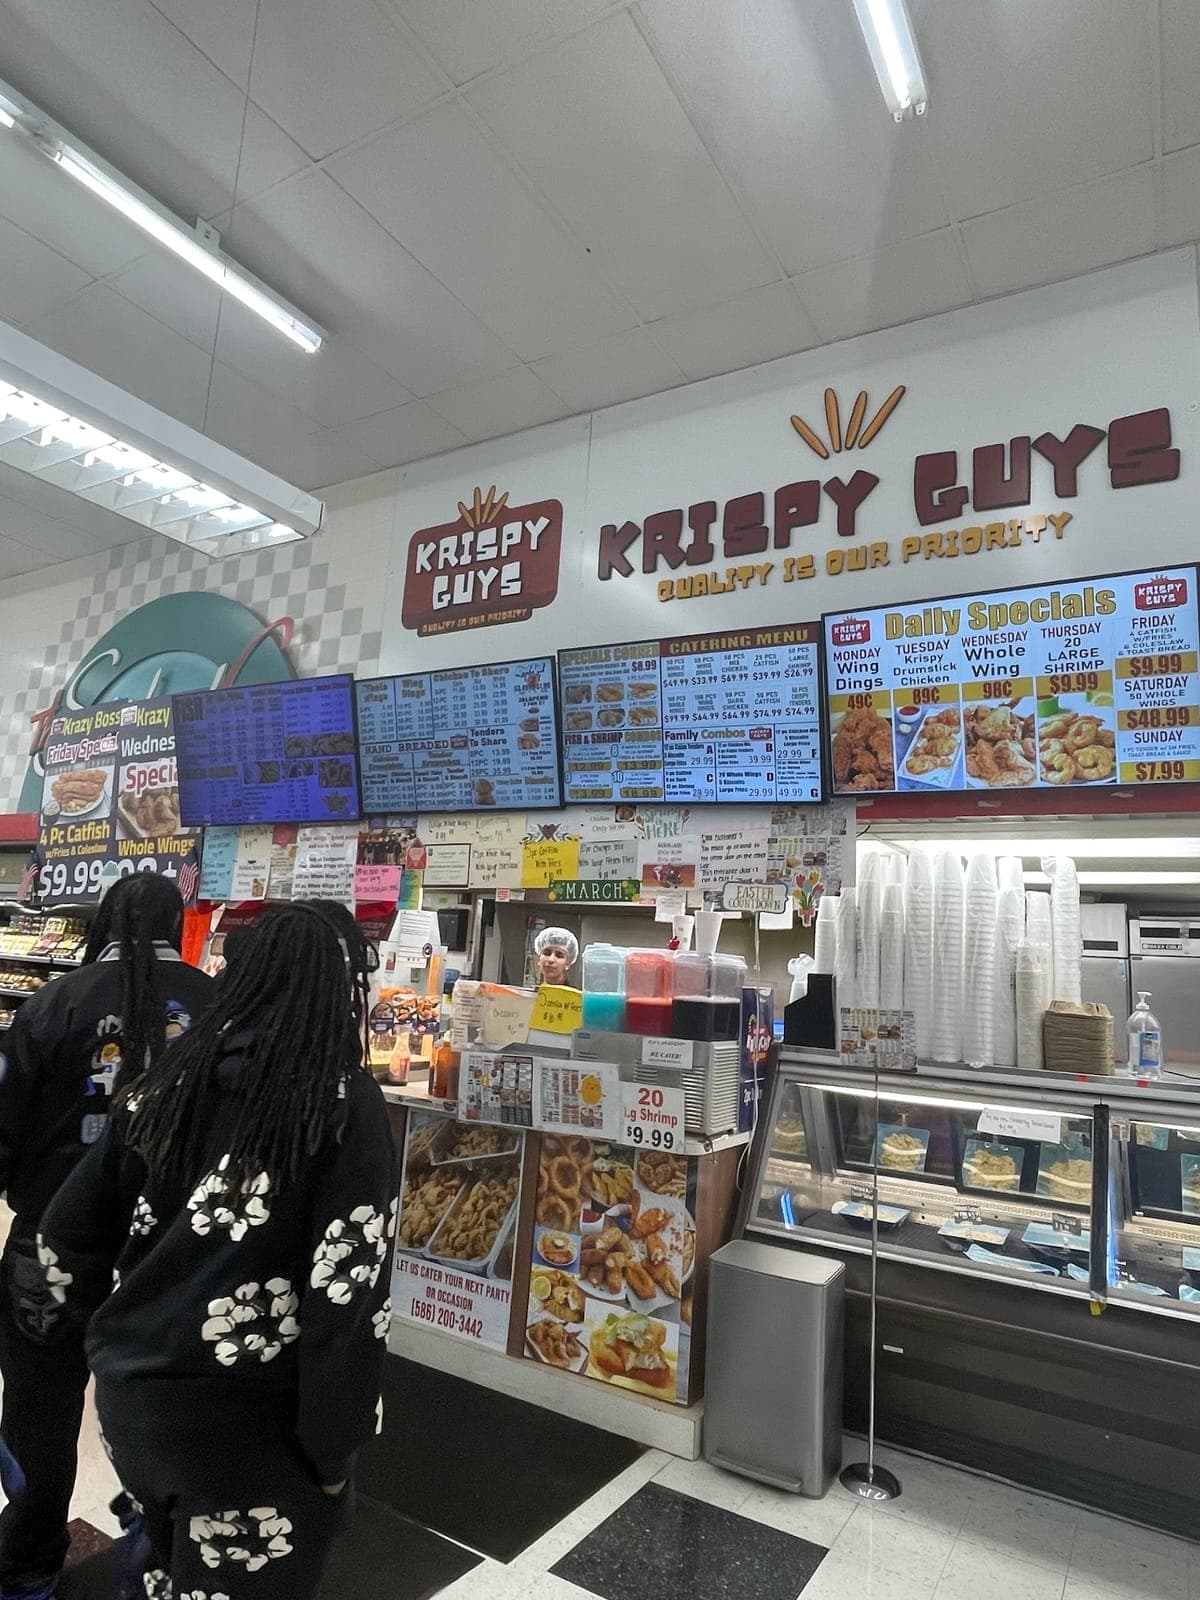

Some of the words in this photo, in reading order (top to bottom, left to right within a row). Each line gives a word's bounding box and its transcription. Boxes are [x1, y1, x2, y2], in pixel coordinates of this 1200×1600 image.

[597, 468, 880, 581] KRISPY
[912, 406, 1182, 527] GUYS
[415, 515, 551, 574] KRISPY
[657, 561, 774, 602] QUALITY
[783, 552, 816, 582] IS
[825, 541, 889, 575] OUR
[902, 511, 1073, 563] PRIORITY
[432, 561, 522, 611] GUYS
[422, 619, 456, 633] QUALITY
[457, 617, 467, 628] IS
[468, 614, 485, 626] OUR
[488, 607, 528, 623] PRIORITY
[884, 607, 962, 641] Daily
[967, 587, 1117, 632] Specials
[1131, 614, 1175, 629] FRIDAY
[1041, 622, 1102, 639] THURSDAY
[1137, 627, 1177, 636] CATFISH
[669, 635, 751, 654] CATERING
[756, 629, 808, 645] MENU
[961, 630, 1028, 648] WEDNESDAY
[1064, 637, 1081, 648] 20
[895, 639, 950, 655] TUESDAY
[965, 645, 1026, 661] Whole
[833, 647, 881, 662] MONDAY
[904, 653, 944, 664] Krispy
[1048, 647, 1099, 662] LARGE
[838, 661, 879, 675] Wing
[893, 662, 957, 676] Drumstick
[971, 663, 1020, 677] Wing
[1044, 660, 1104, 674] SHRIMP
[1130, 653, 1182, 678] $9.99
[721, 673, 749, 683] $69.99
[752, 671, 781, 681] $39.99
[784, 668, 813, 679] $26.99
[900, 675, 950, 686] Chicken
[663, 679, 688, 688] $49.99
[691, 676, 718, 686] $33.99
[836, 677, 883, 691] Dings
[1050, 672, 1098, 695] $9.99
[1124, 675, 1189, 692] SATURDAY
[912, 688, 940, 704] 89¢
[982, 680, 1012, 699] 98¢
[1129, 692, 1142, 700] 50
[1145, 689, 1186, 698] WHOLE
[848, 694, 873, 710] 49¢
[1139, 699, 1176, 708] WINGS
[137, 706, 170, 727] Krazy
[664, 714, 689, 724] $99.99
[692, 712, 719, 722] $64.99
[722, 711, 750, 721] $64.99
[753, 709, 782, 719] $74.99
[785, 707, 815, 717] $74.99
[1126, 707, 1190, 730] $48.99
[63, 713, 94, 736] Krazy
[95, 709, 121, 729] Boss
[470, 728, 505, 737] Tenders
[591, 732, 623, 744] SHRIMP
[665, 730, 698, 741] Family
[701, 728, 746, 740] Combos
[1134, 730, 1183, 744] SUNDAY
[47, 741, 80, 764] Friday
[79, 731, 119, 761] Special
[121, 735, 176, 757] Wednes
[365, 744, 392, 754] HAND
[398, 740, 449, 752] BREADED
[470, 738, 479, 747] To
[481, 737, 508, 746] Share
[766, 743, 773, 752] B
[706, 745, 713, 754] A
[811, 749, 817, 758] F
[706, 773, 713, 783] C
[767, 772, 774, 782] D
[1136, 761, 1184, 781] $7.99
[749, 788, 773, 797] 29.99
[810, 788, 818, 797] G
[40, 830, 48, 846] 4
[50, 829, 64, 845] Pc
[67, 821, 110, 843] Catfish
[592, 825, 606, 833] Only
[647, 822, 680, 840] HERE
[71, 846, 76, 855] &
[118, 839, 155, 857] Whole
[157, 838, 195, 856] Wings
[38, 860, 104, 900] $9.99
[566, 883, 622, 899] MARCH
[737, 885, 774, 899] EASTER
[728, 897, 780, 910] COUNTDOWN
[638, 1087, 664, 1108] 20
[640, 1108, 678, 1128] Shrimp
[627, 1126, 674, 1150] $9.99
[396, 1259, 409, 1272] LET
[410, 1262, 419, 1275] US
[421, 1265, 443, 1281] CATER
[445, 1272, 463, 1289] YOUR
[464, 1278, 484, 1296] NEXT
[485, 1285, 510, 1304] PARTY
[426, 1286, 436, 1299] OR
[437, 1290, 473, 1311] OCCASION
[411, 1298, 435, 1323] (586)
[438, 1308, 483, 1338] 200-3442
